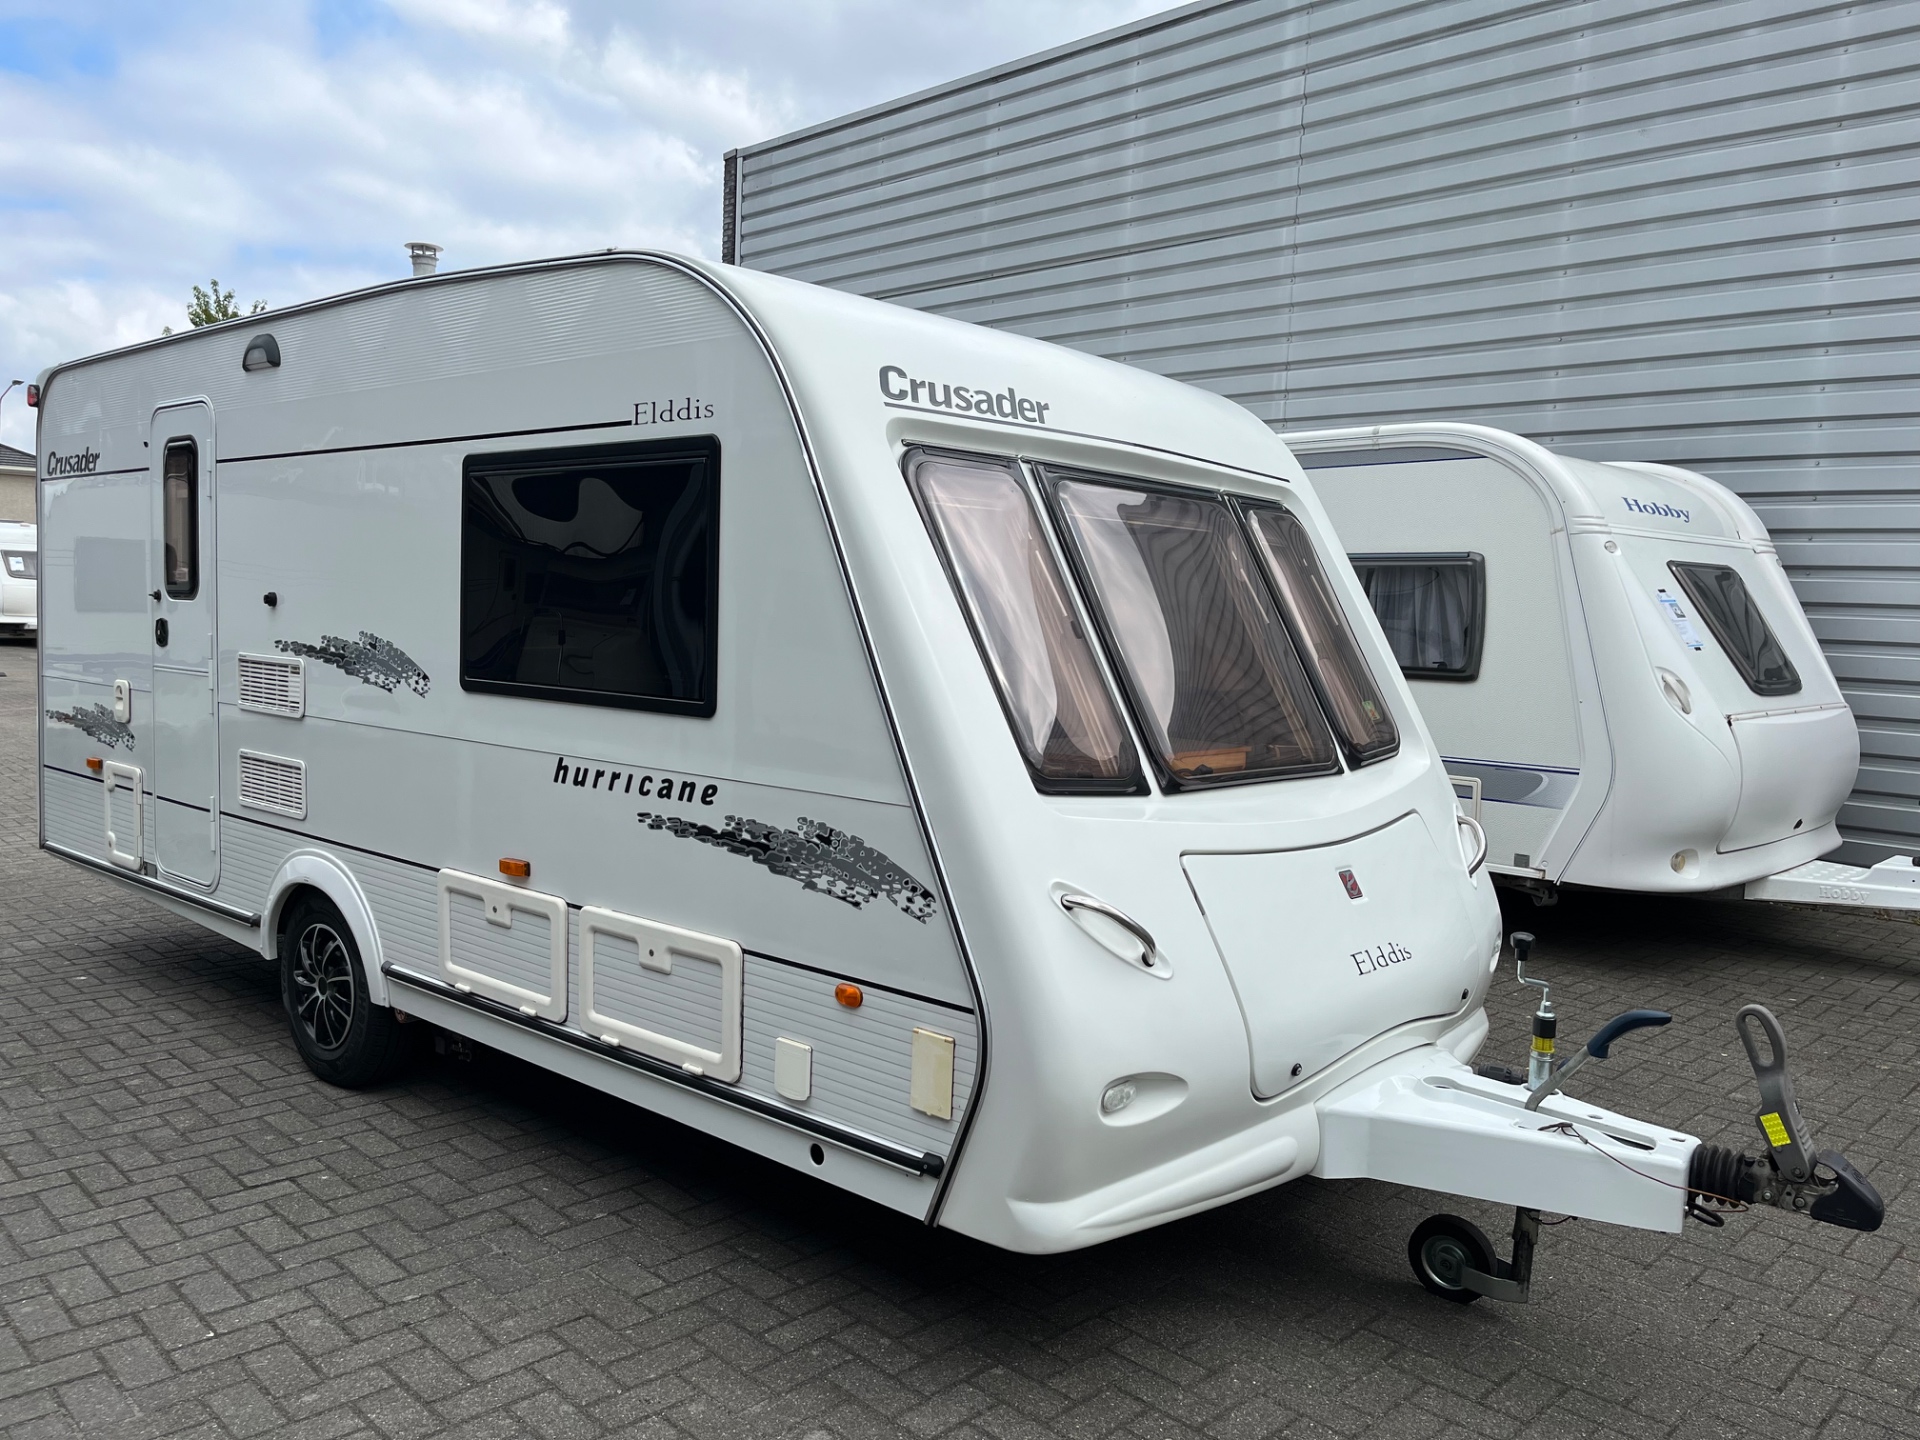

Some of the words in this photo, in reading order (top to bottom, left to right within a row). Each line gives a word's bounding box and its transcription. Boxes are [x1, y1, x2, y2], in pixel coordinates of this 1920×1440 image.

[879, 365, 1050, 424] Crusader
[633, 397, 714, 426] Elddis
[47, 446, 100, 476] Crusader
[1621, 497, 1690, 523] Hobby
[553, 757, 718, 806] hurricane
[1819, 885, 1870, 904] Hobby
[1350, 942, 1412, 976] Elddis
